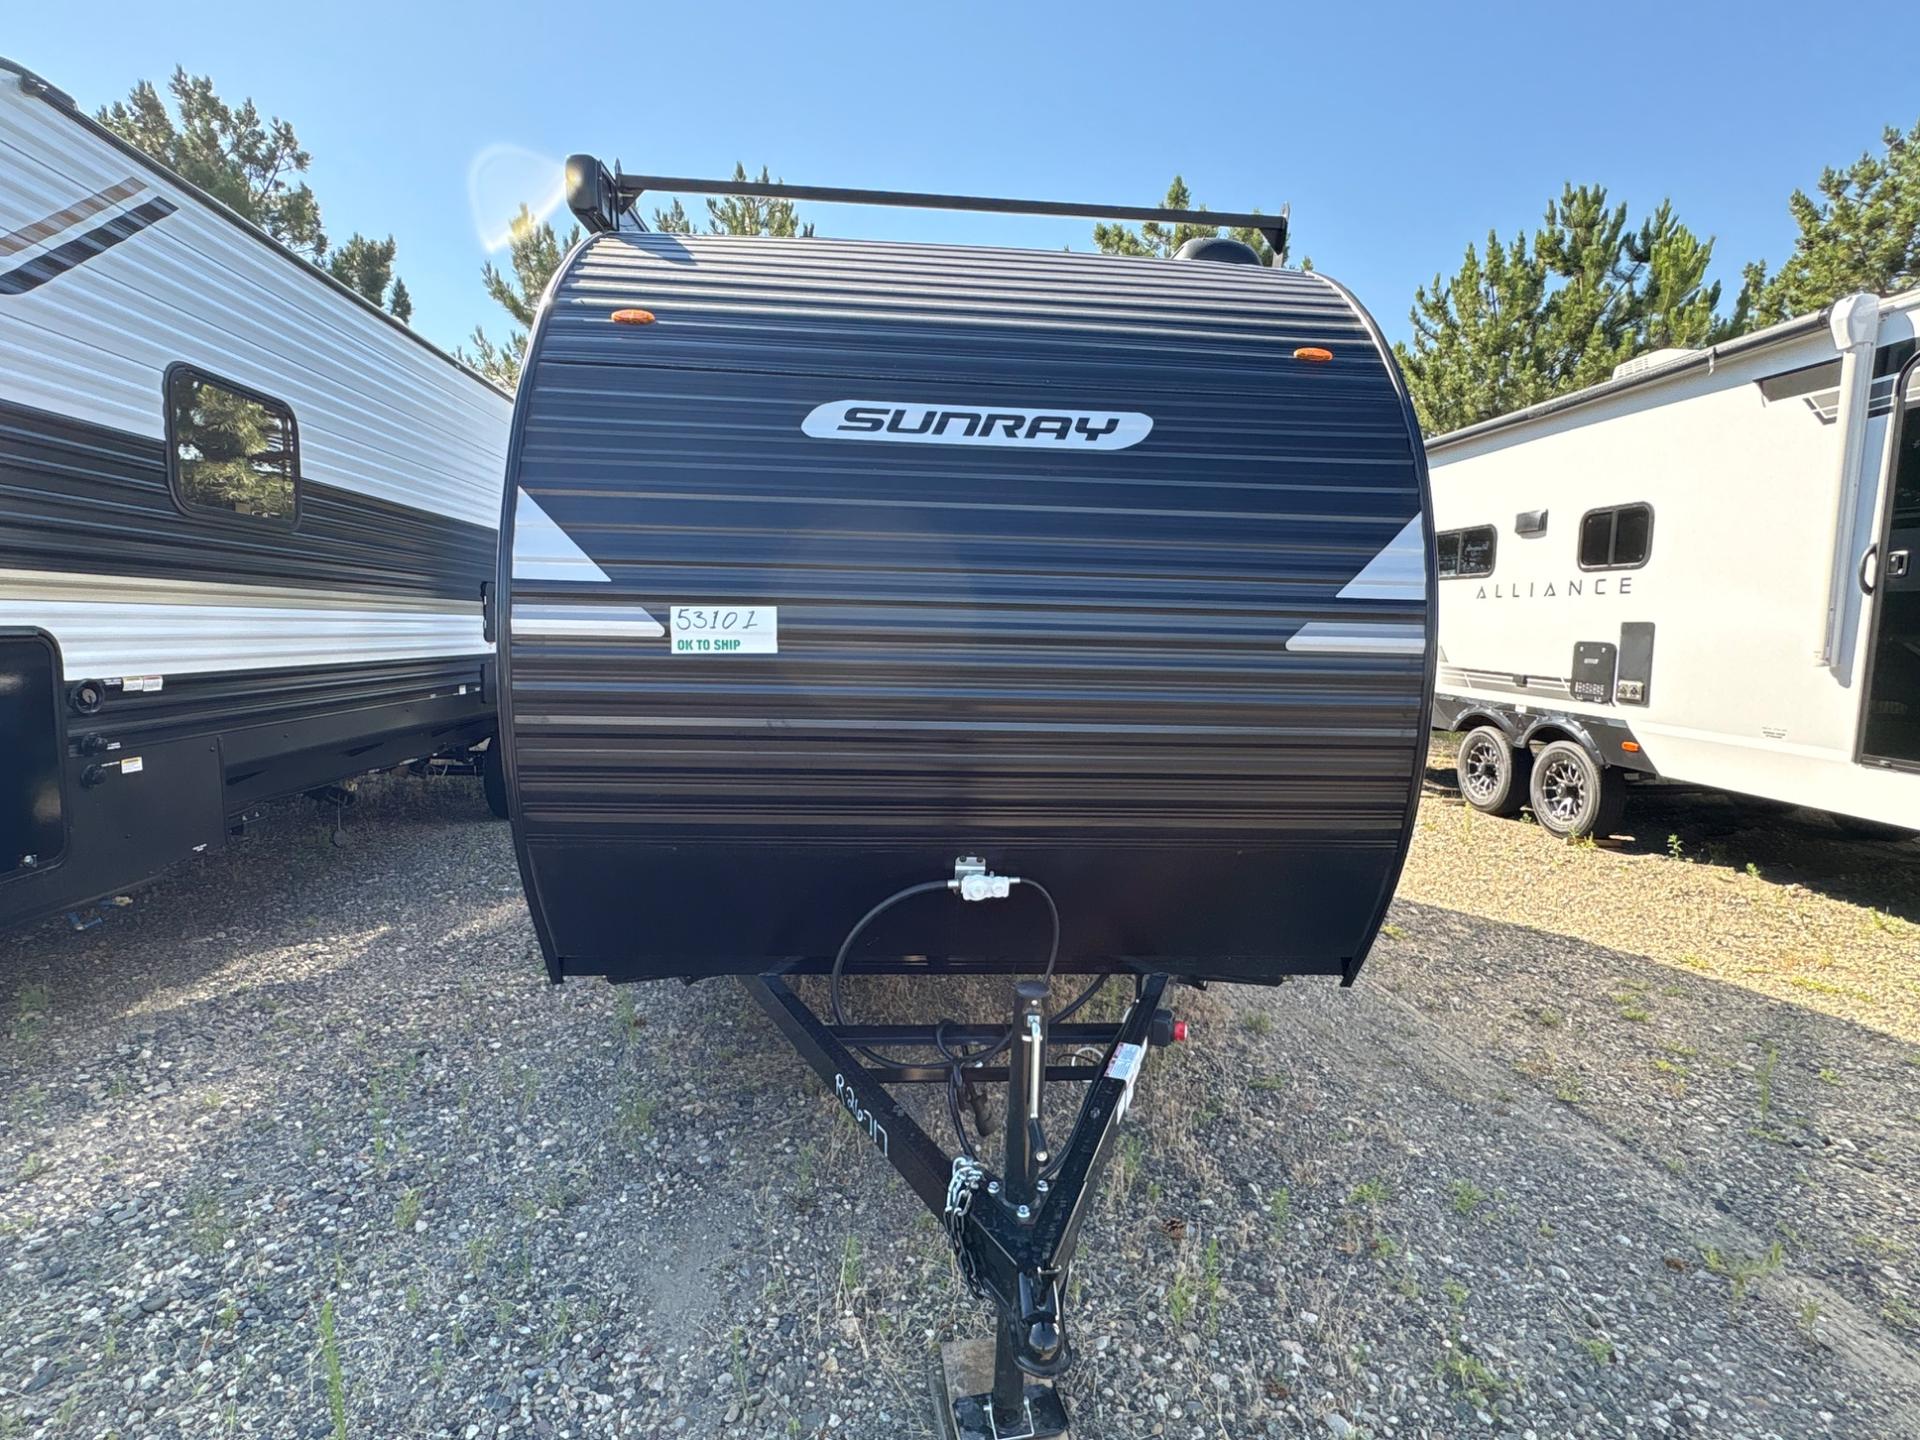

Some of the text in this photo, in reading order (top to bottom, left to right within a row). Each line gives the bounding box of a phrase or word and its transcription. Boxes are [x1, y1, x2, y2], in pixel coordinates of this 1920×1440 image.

[837, 407, 1120, 441] SUNRAY
[1476, 577, 1632, 599] ALLIANCE
[676, 608, 758, 630] 53101
[677, 639, 741, 651] OK TO SHIP
